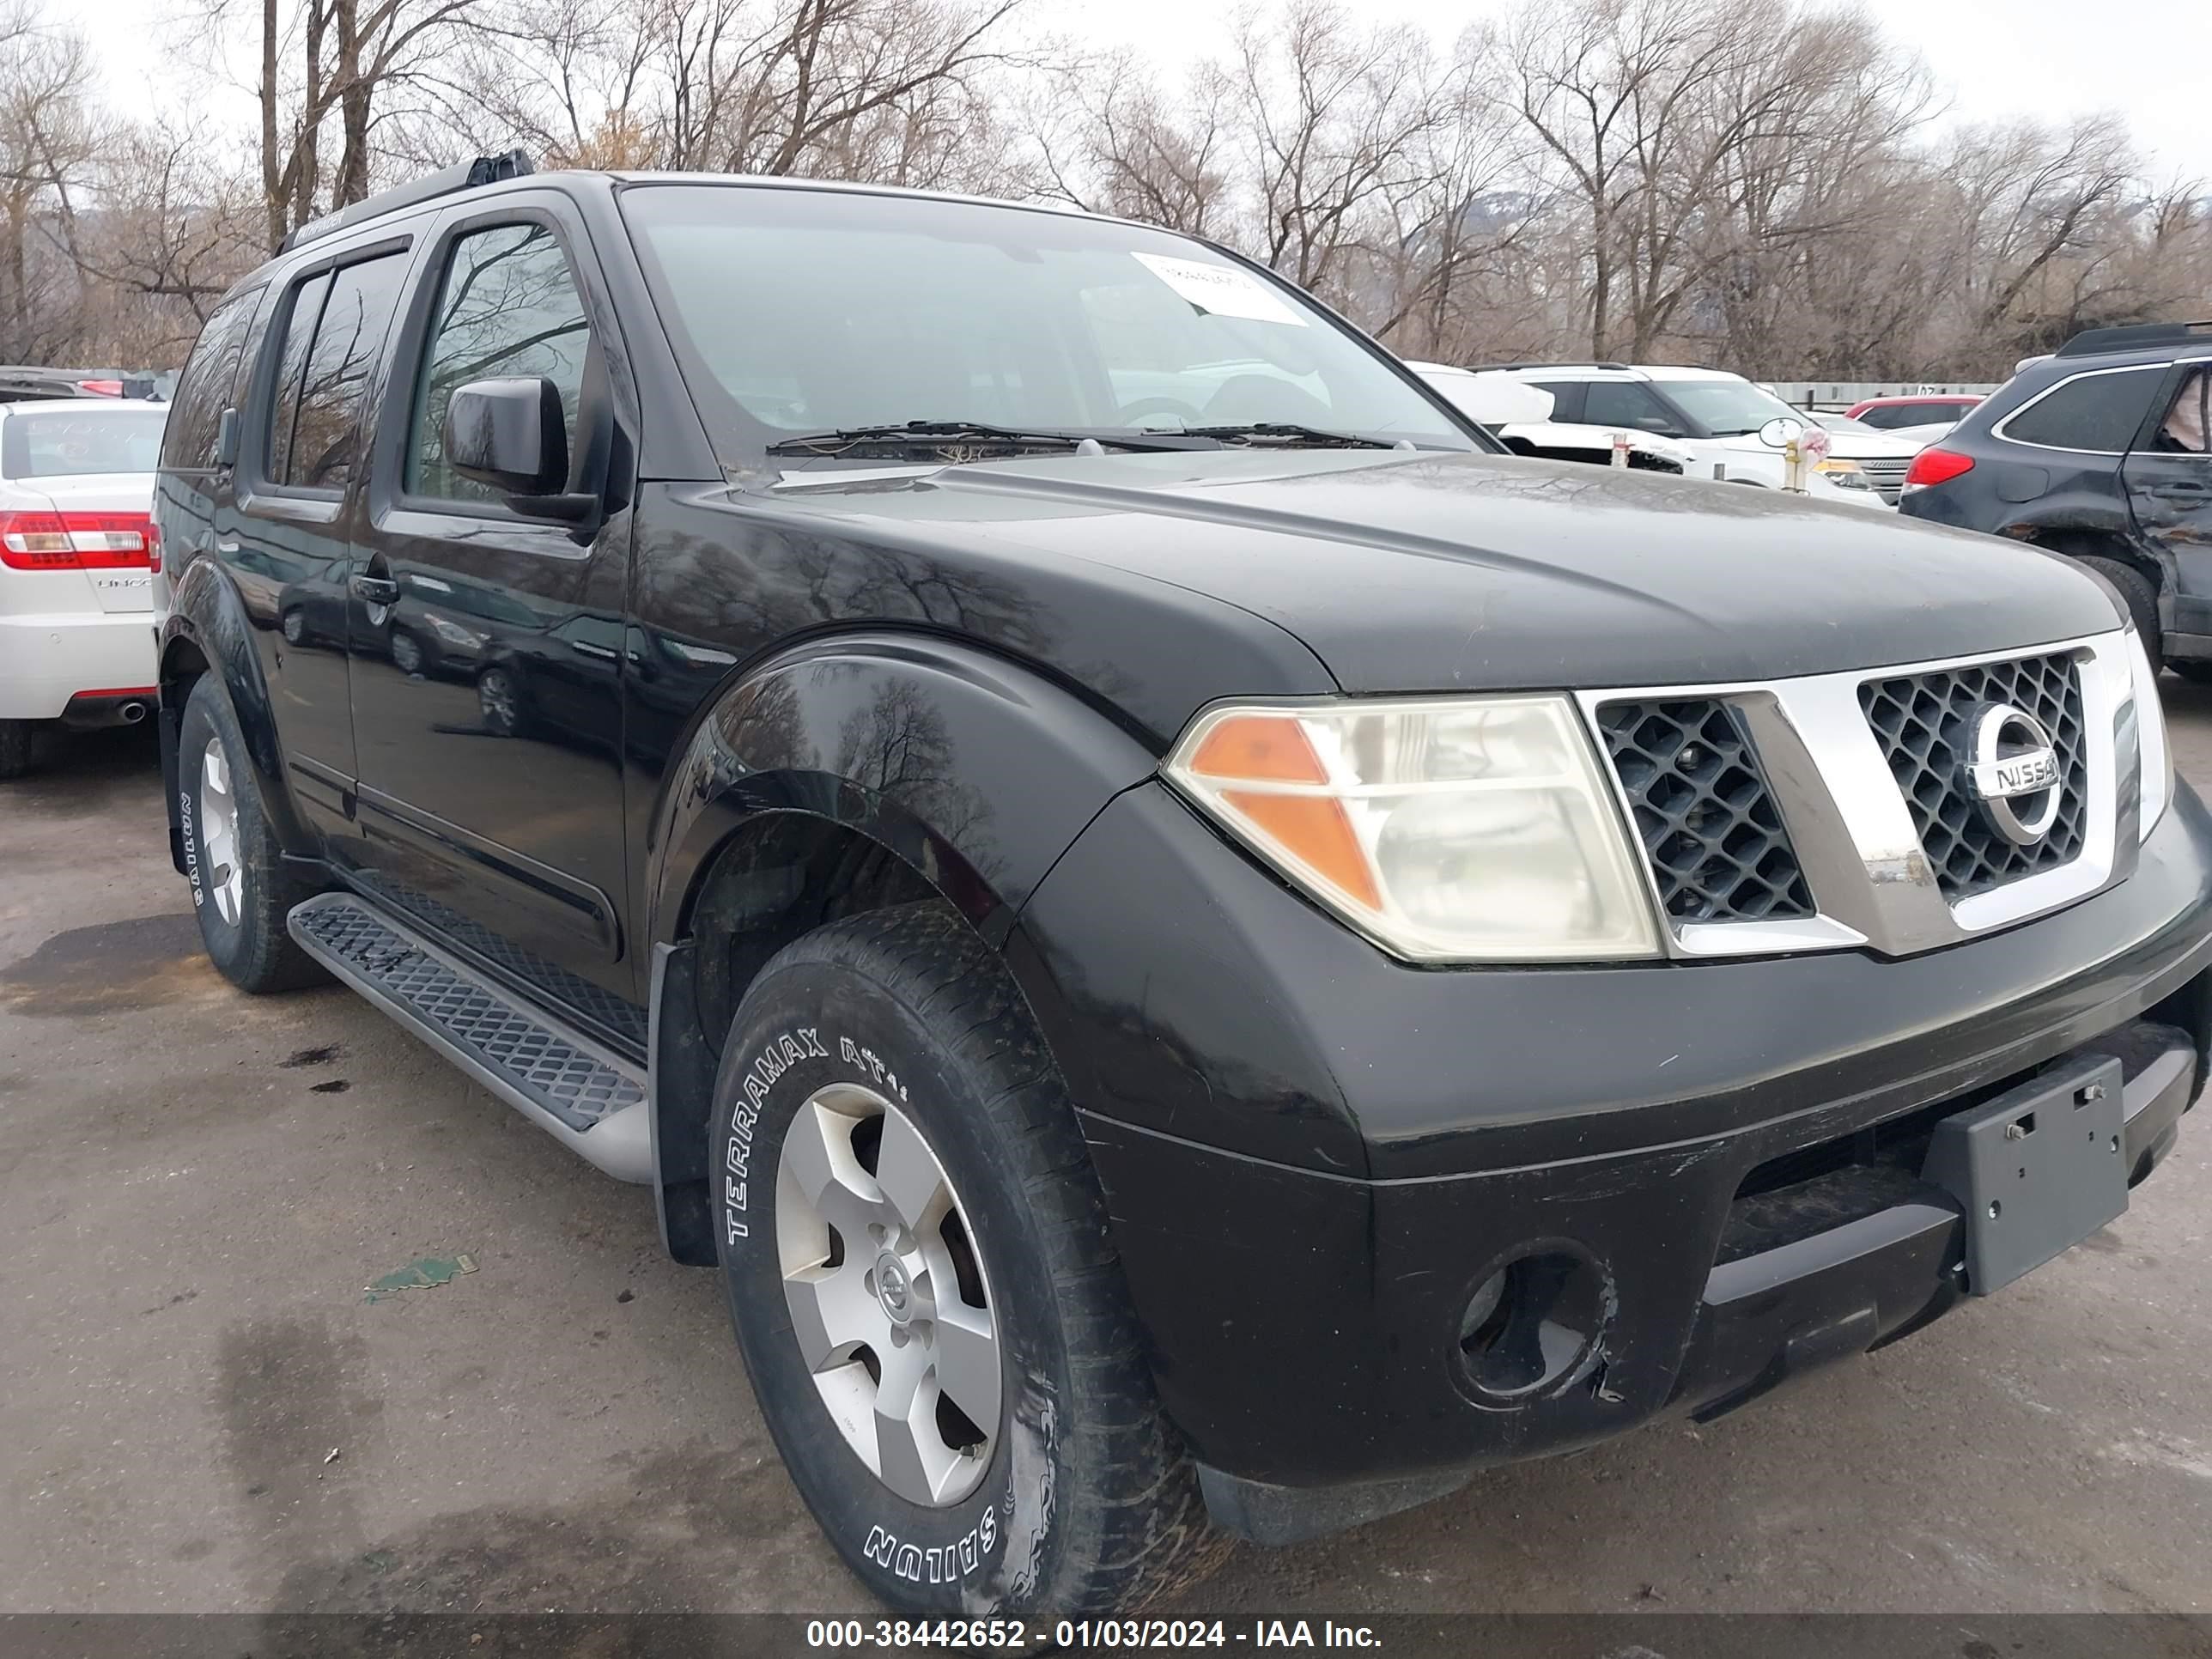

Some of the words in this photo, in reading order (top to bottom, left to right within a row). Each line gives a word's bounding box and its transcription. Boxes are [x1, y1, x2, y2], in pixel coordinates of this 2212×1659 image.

[181, 792, 204, 907] SAILUN
[726, 1028, 829, 1246] TERRAMAX
[863, 1504, 996, 1583] SAILUN
